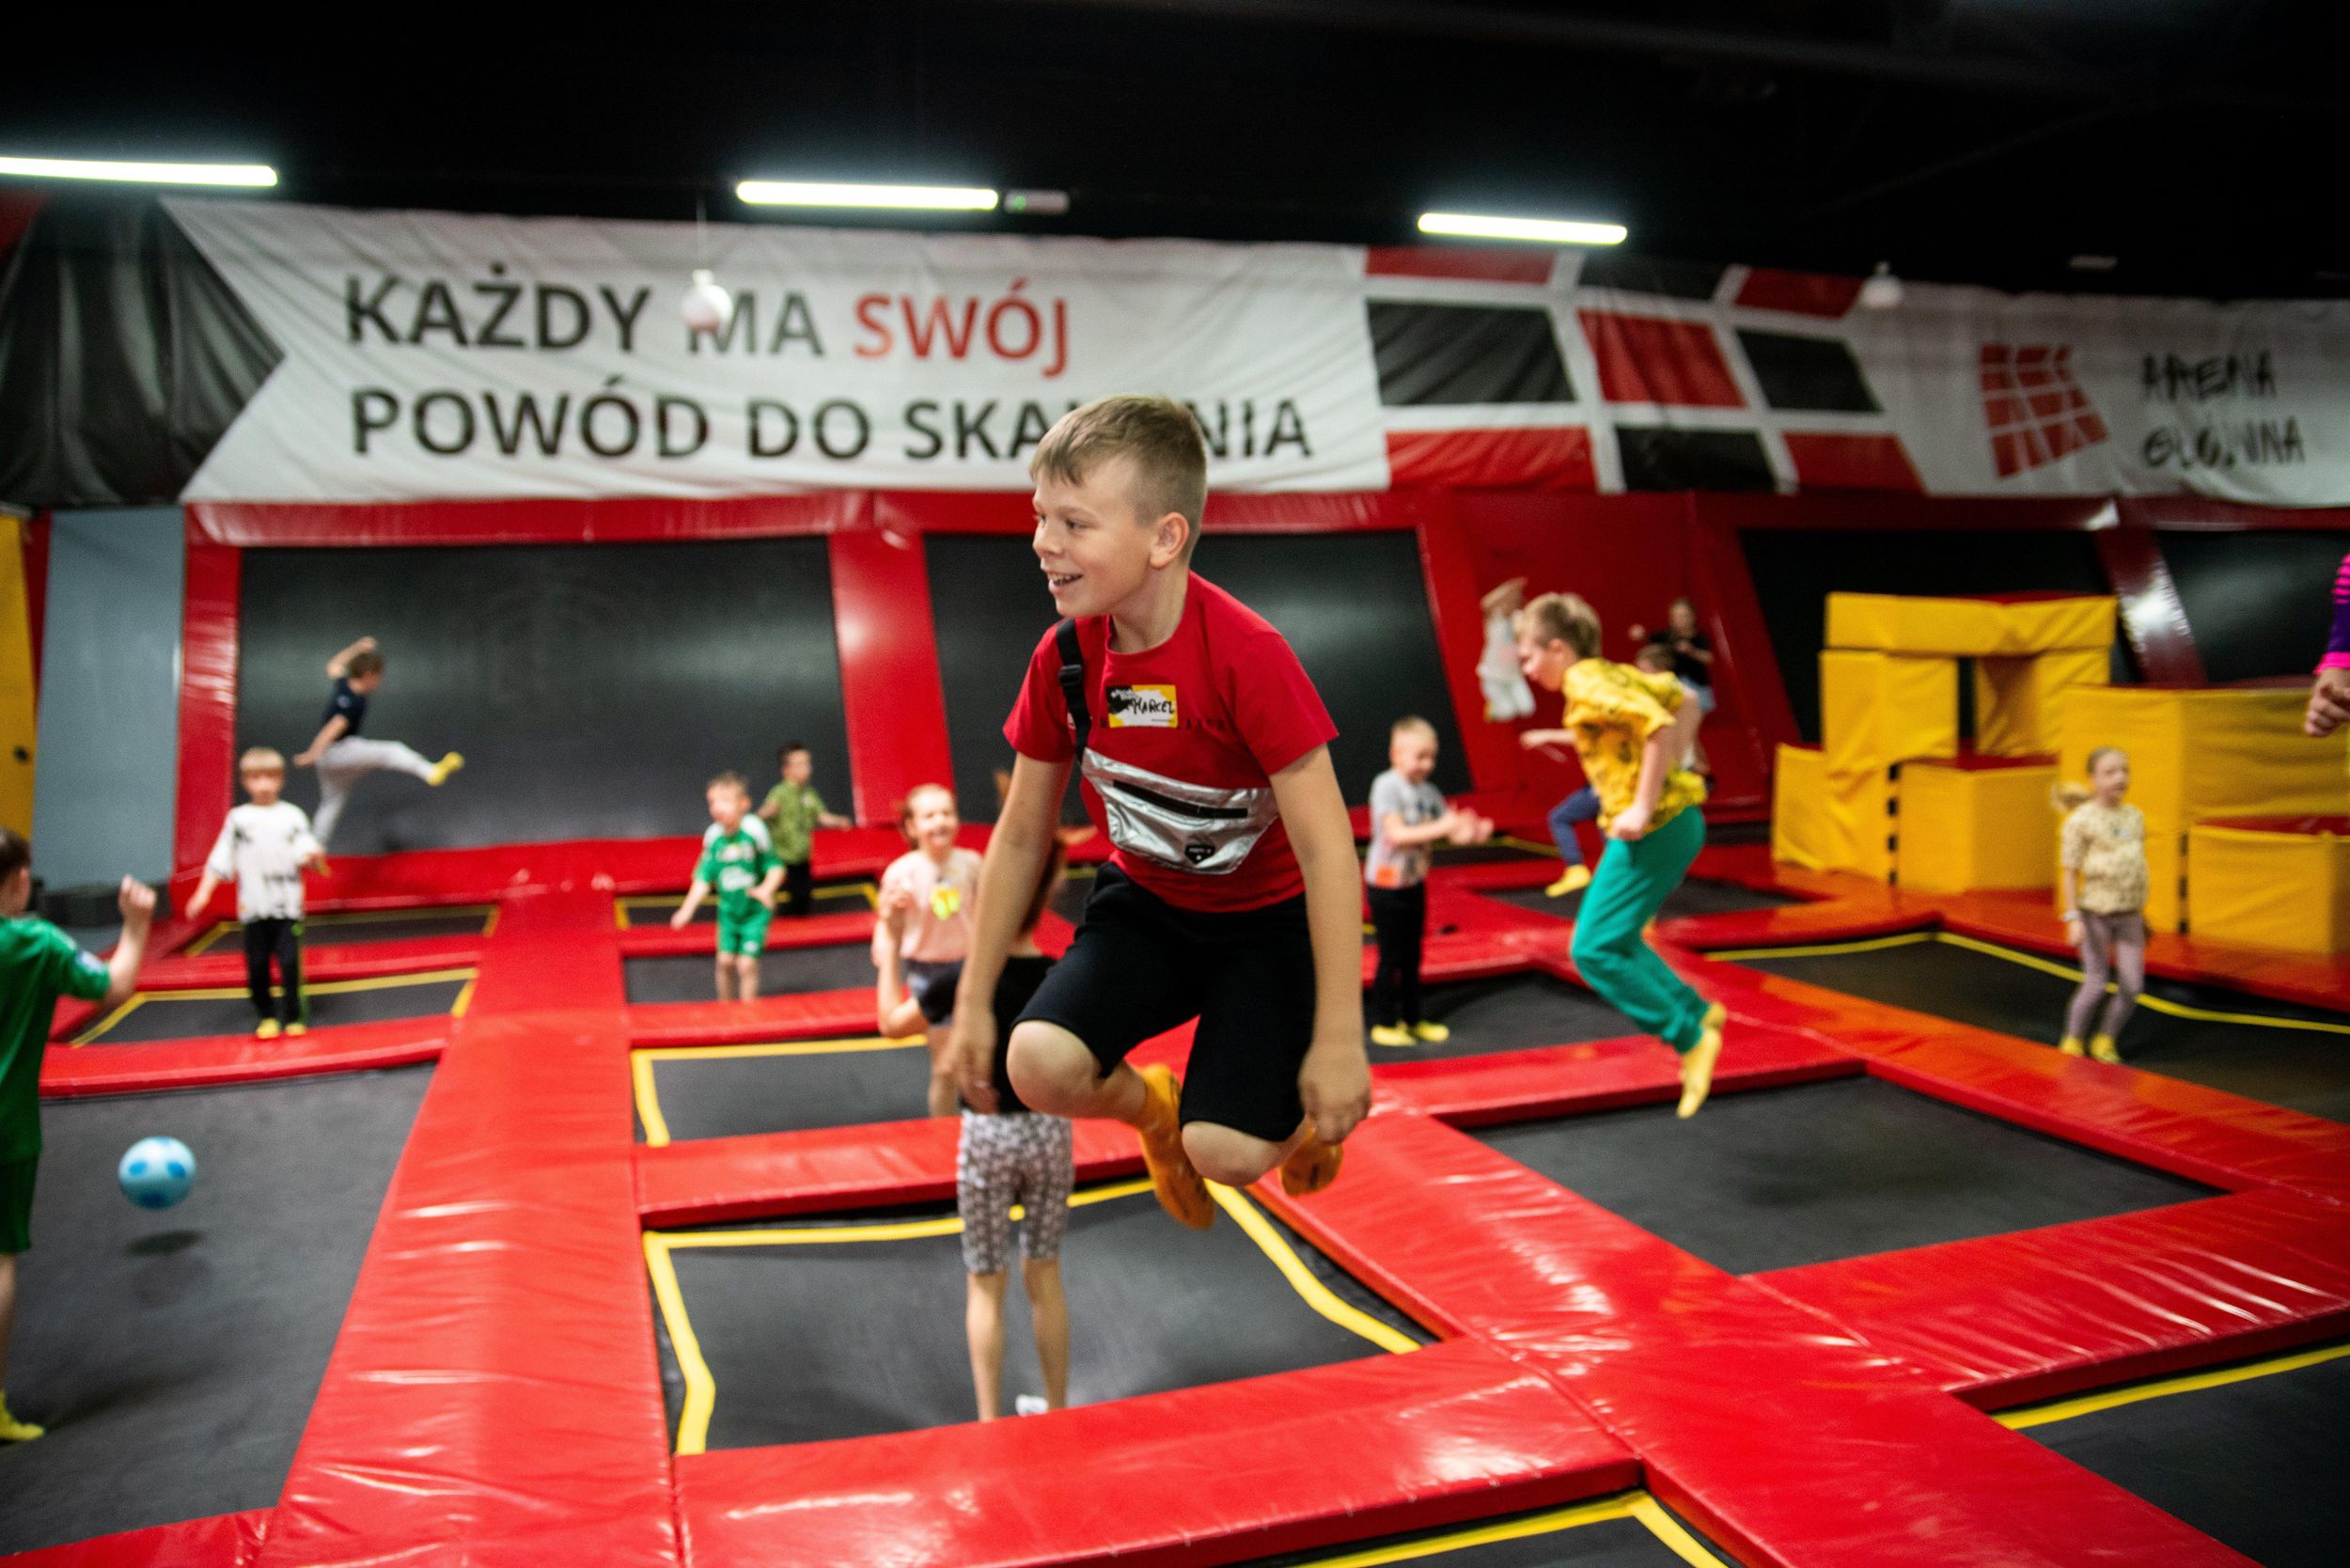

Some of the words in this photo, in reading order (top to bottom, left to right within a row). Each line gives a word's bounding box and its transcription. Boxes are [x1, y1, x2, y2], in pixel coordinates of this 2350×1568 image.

[346, 262, 650, 352] KAŻDY
[686, 290, 824, 354] MA
[854, 276, 1069, 378] SWÓJ
[352, 373, 710, 458] POWÓD
[748, 399, 870, 460] DO
[903, 396, 1312, 460] SKANIA
